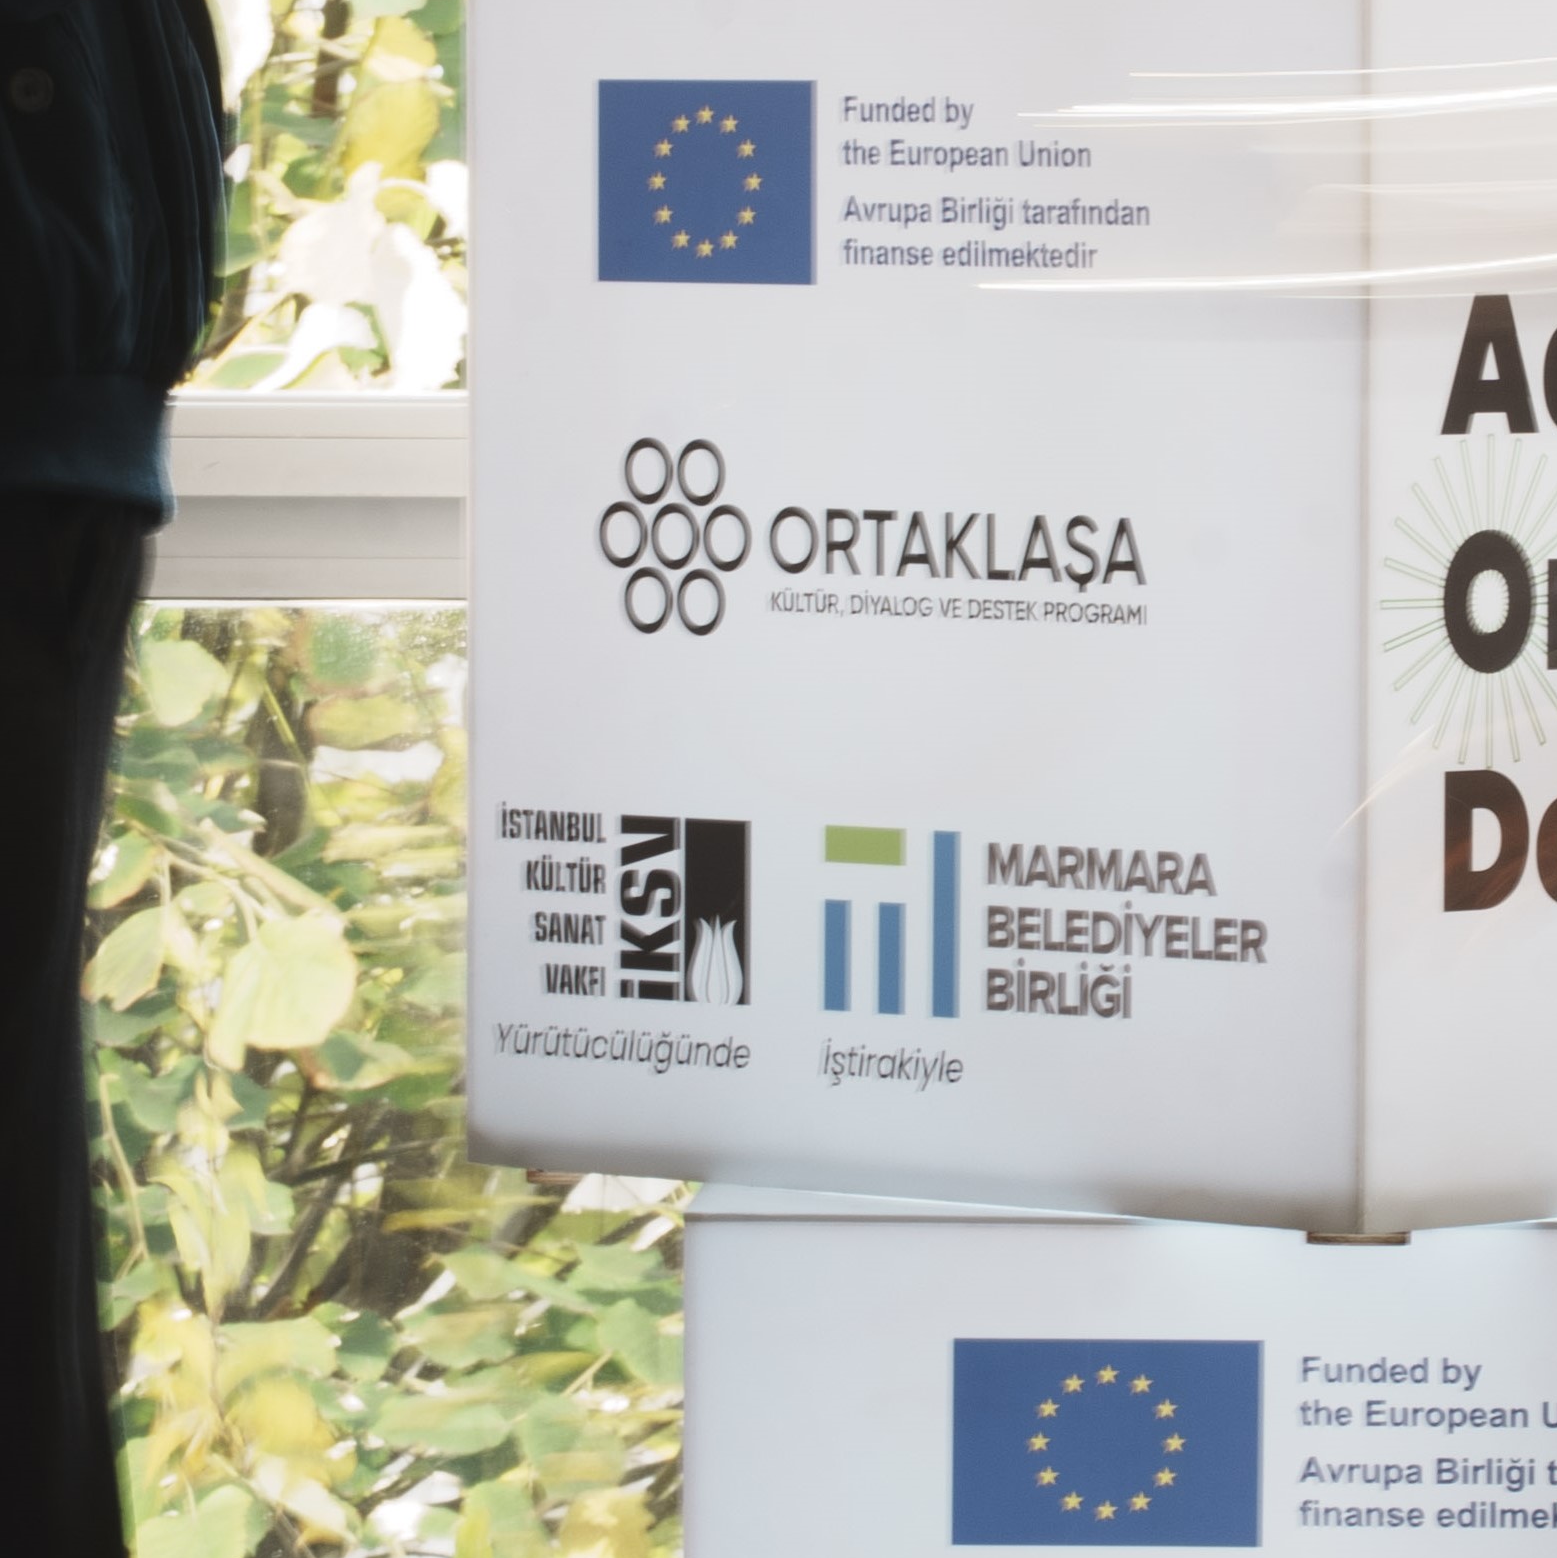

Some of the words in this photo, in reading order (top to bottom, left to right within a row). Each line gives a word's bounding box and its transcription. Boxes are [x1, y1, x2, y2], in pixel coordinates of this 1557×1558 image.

[844, 96, 935, 123] Funded
[944, 97, 973, 130] by
[842, 140, 880, 165] the
[890, 139, 1008, 172] European
[1019, 141, 1091, 167] Union
[844, 196, 931, 228] Avrupa
[941, 197, 1013, 231] Birliği
[1022, 198, 1149, 226] tarafından
[843, 238, 933, 266] finanse
[942, 241, 1097, 268] edilmektedir
[768, 506, 1146, 593] ORTAKLAŞA
[850, 591, 933, 617] DİYALOG
[939, 598, 961, 618] VE
[968, 599, 1036, 621] DESTEK
[1043, 602, 1146, 624] PROGRAMI
[500, 802, 605, 843] İSTANBUL
[526, 855, 605, 894] KÜLTÜR
[988, 843, 1216, 896] MARMARA
[534, 912, 605, 944] SANAT
[987, 902, 1266, 963] BELEDİYELER
[546, 964, 604, 996] VAKFI
[986, 957, 1130, 1018] BİRLİĞİ
[495, 1023, 750, 1074] Yürütücülüğünde
[823, 1039, 963, 1091] İştirakiyle
[1302, 1356, 1428, 1384] Funded
[1442, 1358, 1481, 1391] by
[1299, 1400, 1352, 1426] the
[1366, 1400, 1528, 1434] European
[1300, 1457, 1422, 1490] Avrupa
[1436, 1458, 1535, 1492] Birliği
[1299, 1500, 1424, 1527] finanse
